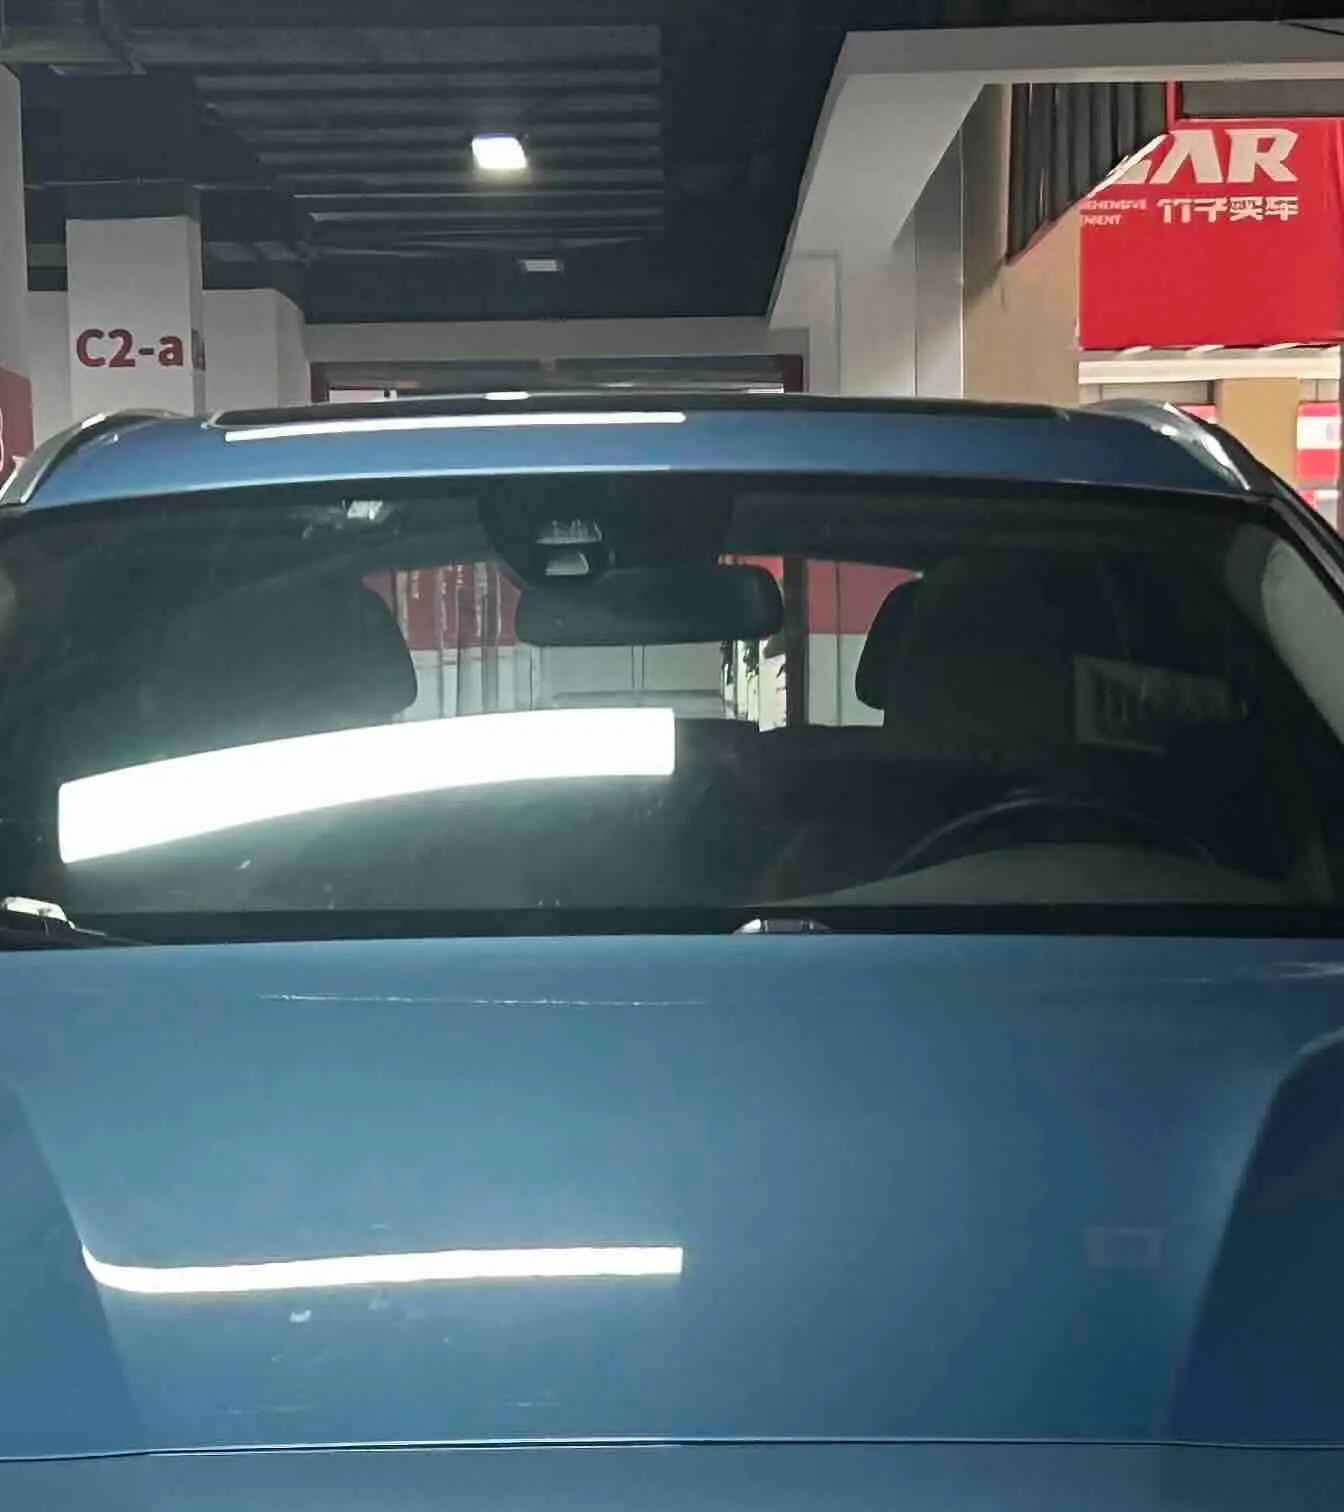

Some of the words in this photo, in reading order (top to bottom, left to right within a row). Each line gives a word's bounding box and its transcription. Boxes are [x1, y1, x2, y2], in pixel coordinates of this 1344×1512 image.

[1158, 196, 1299, 223] 竹子买车
[76, 328, 184, 368] C2-a
